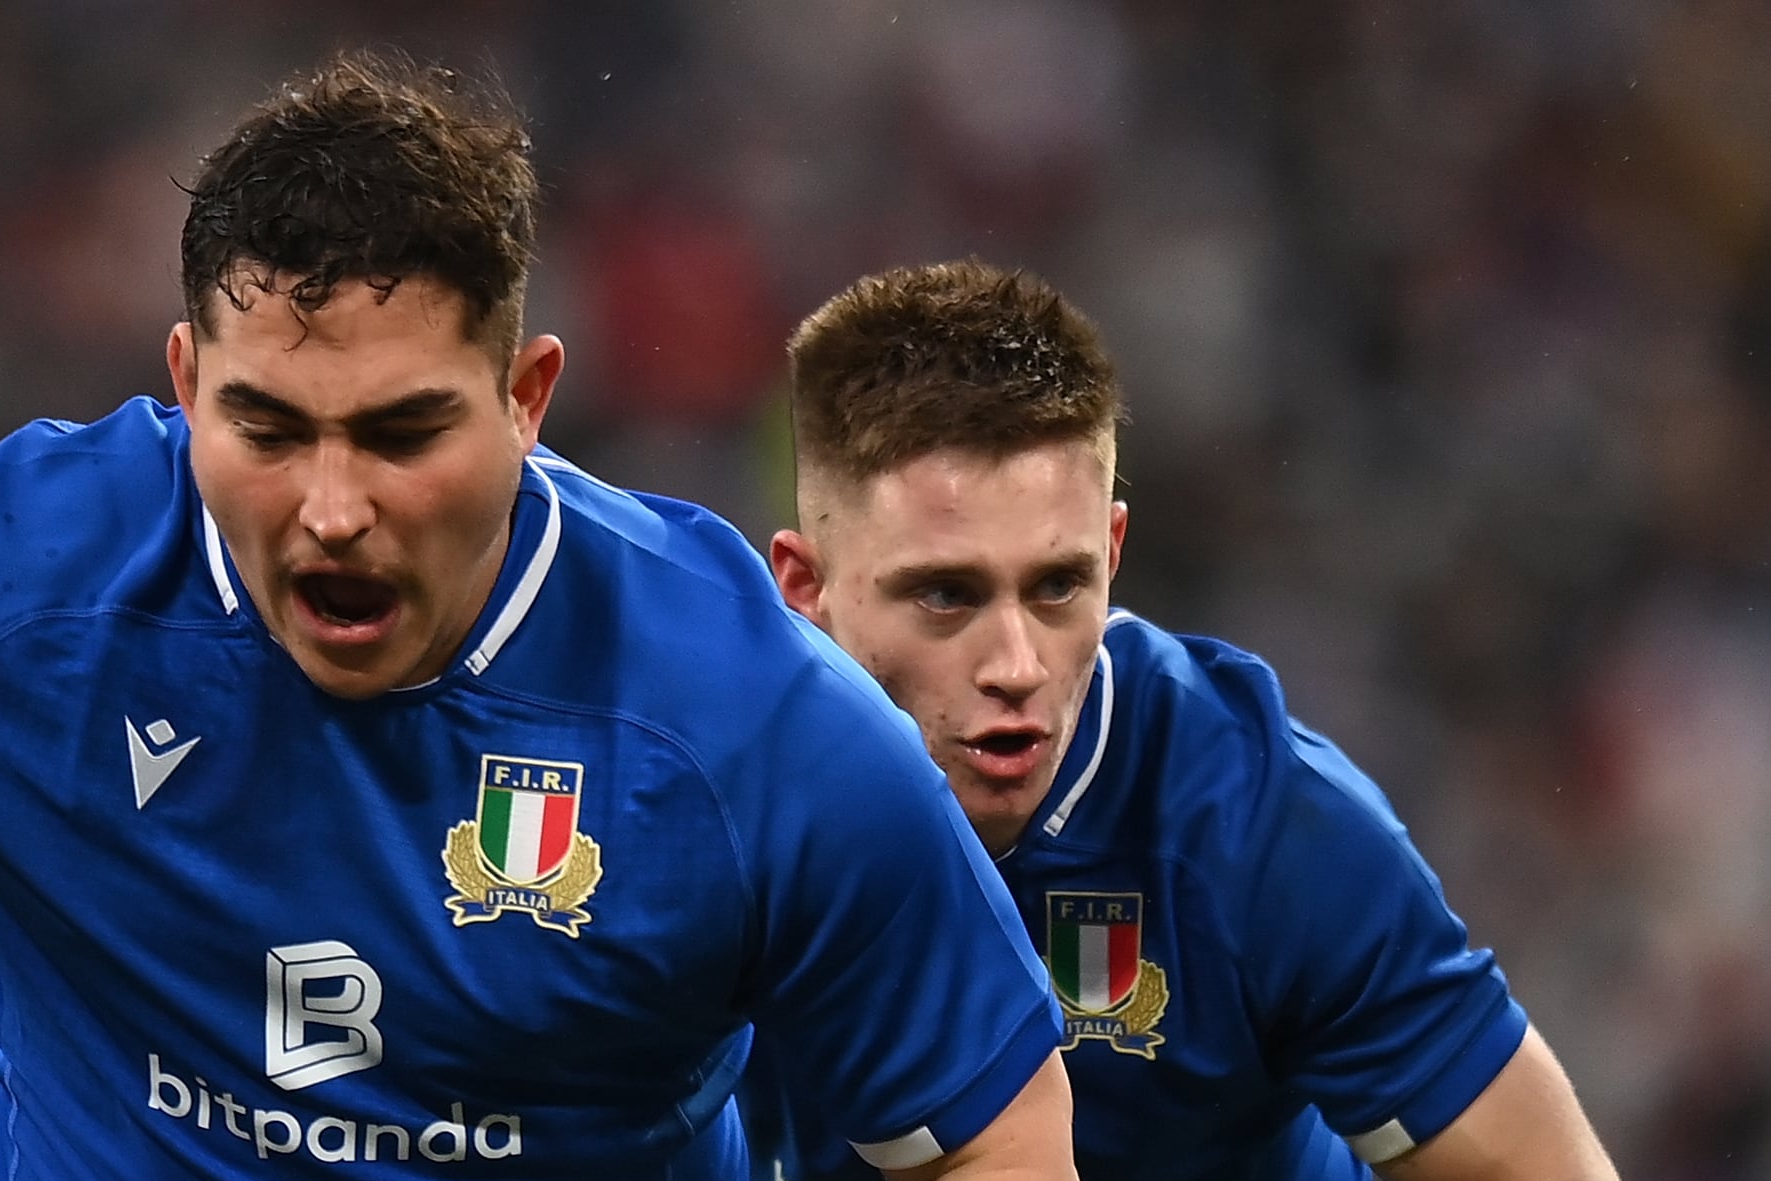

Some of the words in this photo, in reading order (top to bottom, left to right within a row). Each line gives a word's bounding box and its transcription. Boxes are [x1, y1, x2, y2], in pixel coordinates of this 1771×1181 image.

[494, 766, 569, 791] F.I.R.
[488, 891, 548, 911] ITALIA
[1061, 902, 1131, 920] F.I.R.
[1066, 1021, 1123, 1036] ITALIA
[147, 1053, 523, 1161] bitpanda
